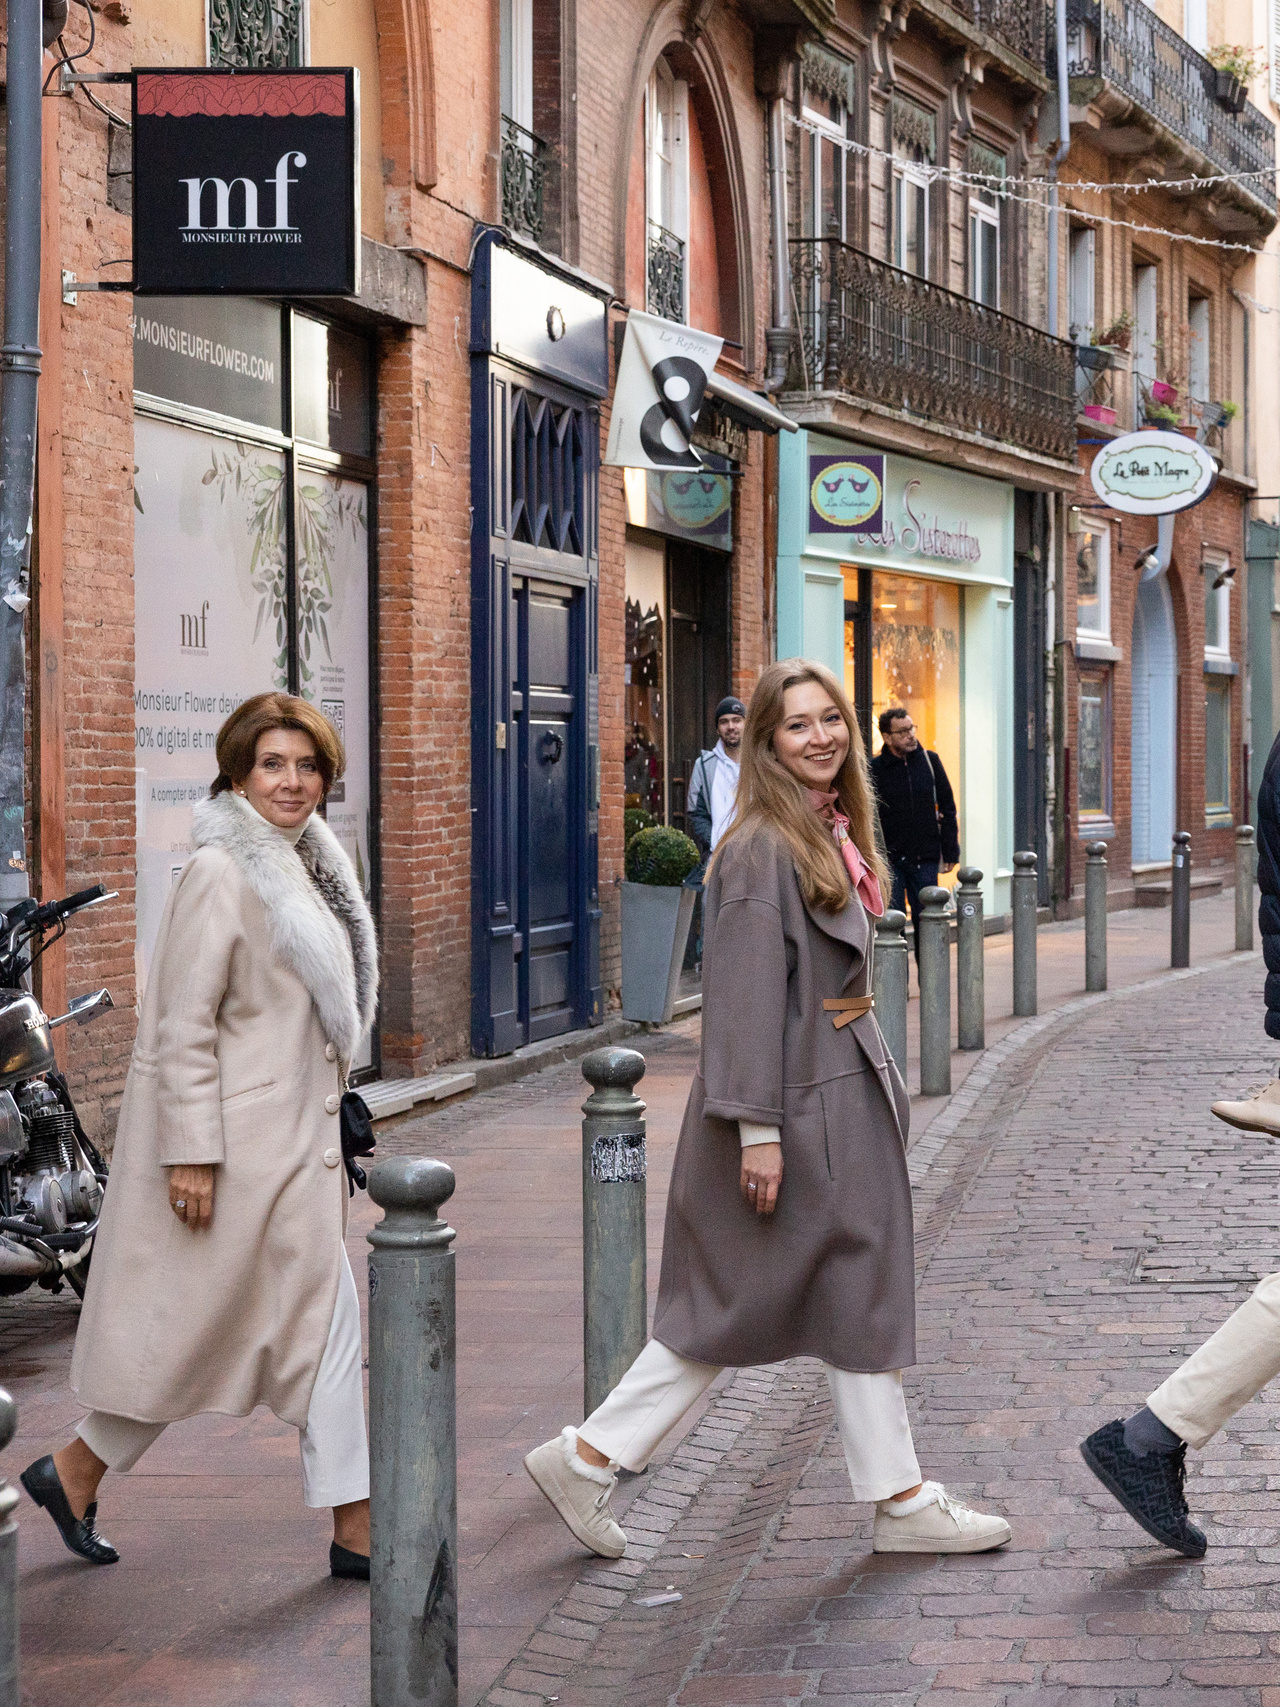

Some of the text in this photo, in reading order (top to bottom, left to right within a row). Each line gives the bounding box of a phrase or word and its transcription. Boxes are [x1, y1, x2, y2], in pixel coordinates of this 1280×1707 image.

[178, 151, 307, 230] mf
[182, 232, 302, 243] MONSIEUR FLOWER
[1113, 462, 1129, 479] Le
[1128, 460, 1150, 477] Petit
[179, 599, 209, 648] mf
[133, 689, 182, 712] Monsieur
[184, 690, 217, 713] Flower
[156, 726, 190, 755] digital
[192, 728, 203, 748] et
[157, 788, 187, 806] compter
[188, 786, 197, 800] de
